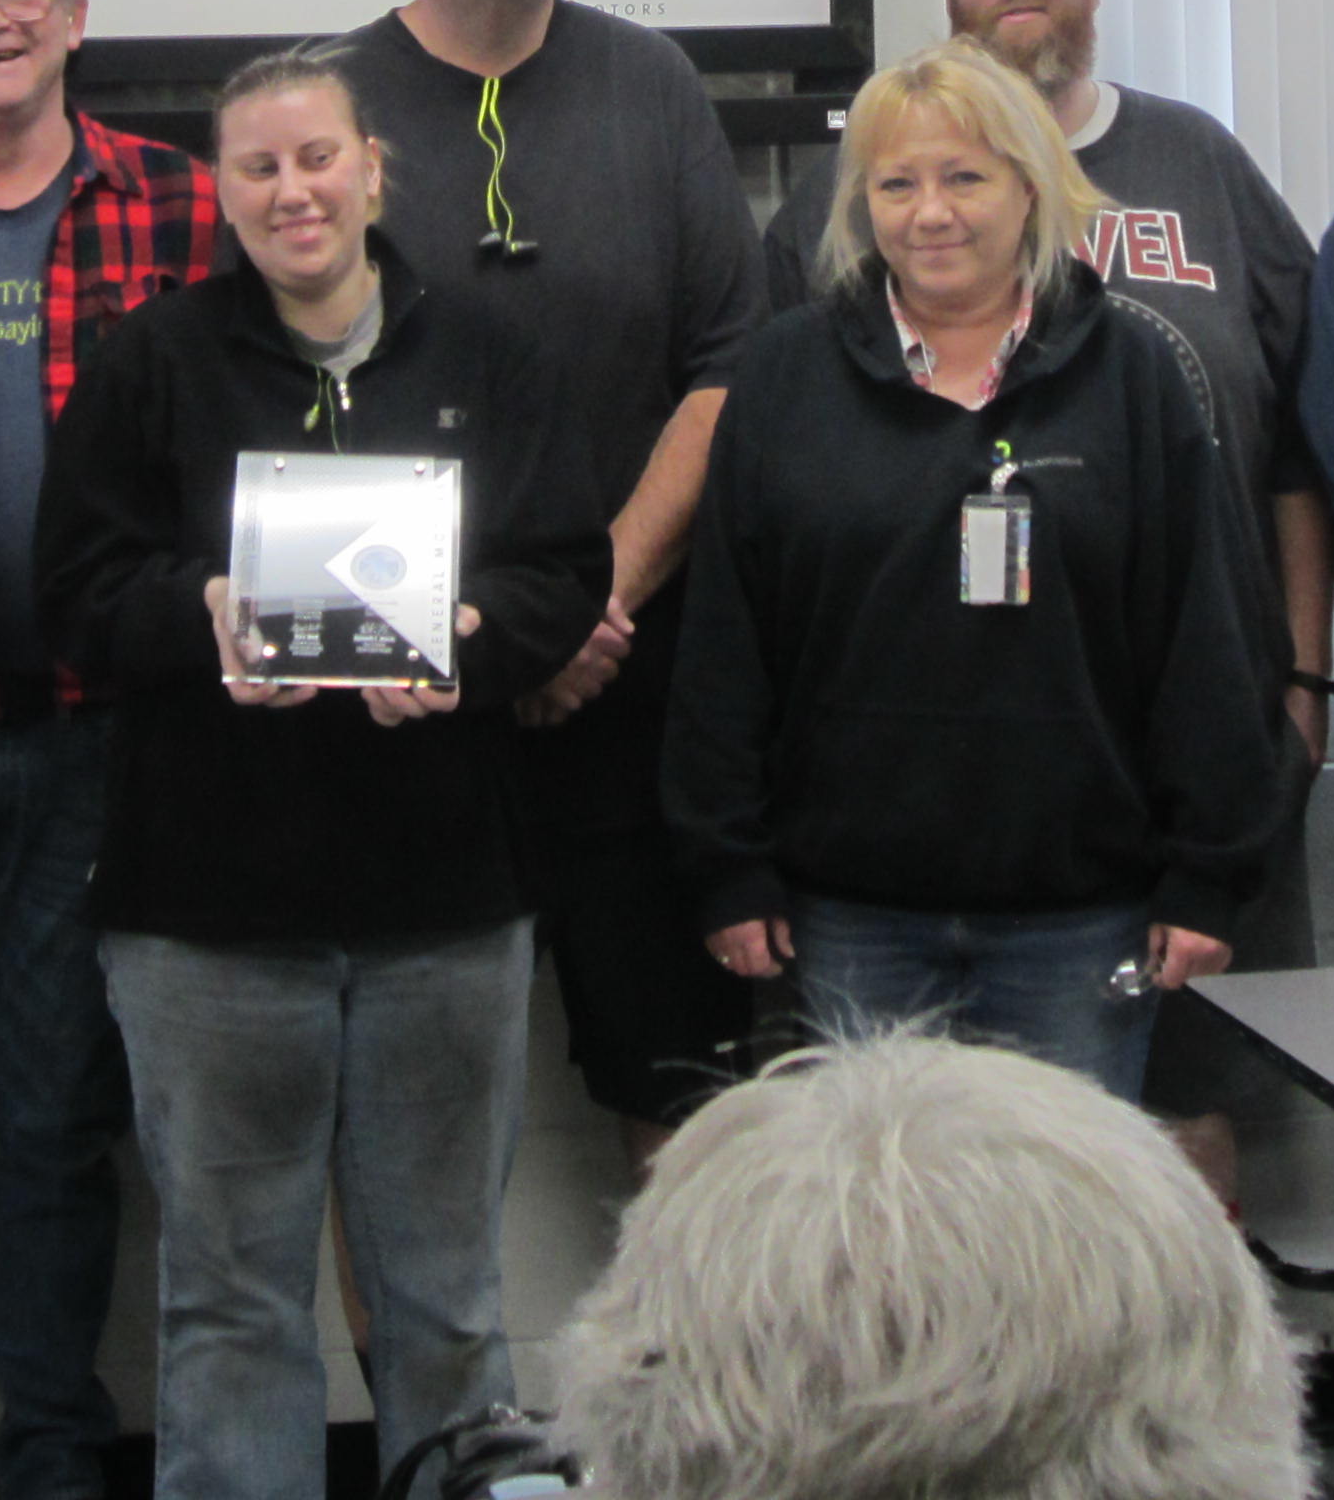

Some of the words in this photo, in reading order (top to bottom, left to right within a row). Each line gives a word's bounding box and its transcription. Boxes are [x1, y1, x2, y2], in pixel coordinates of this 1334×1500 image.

[594, 3, 665, 16] OTORS
[1070, 209, 1216, 291] VEL
[429, 570, 446, 660] GENERAL
